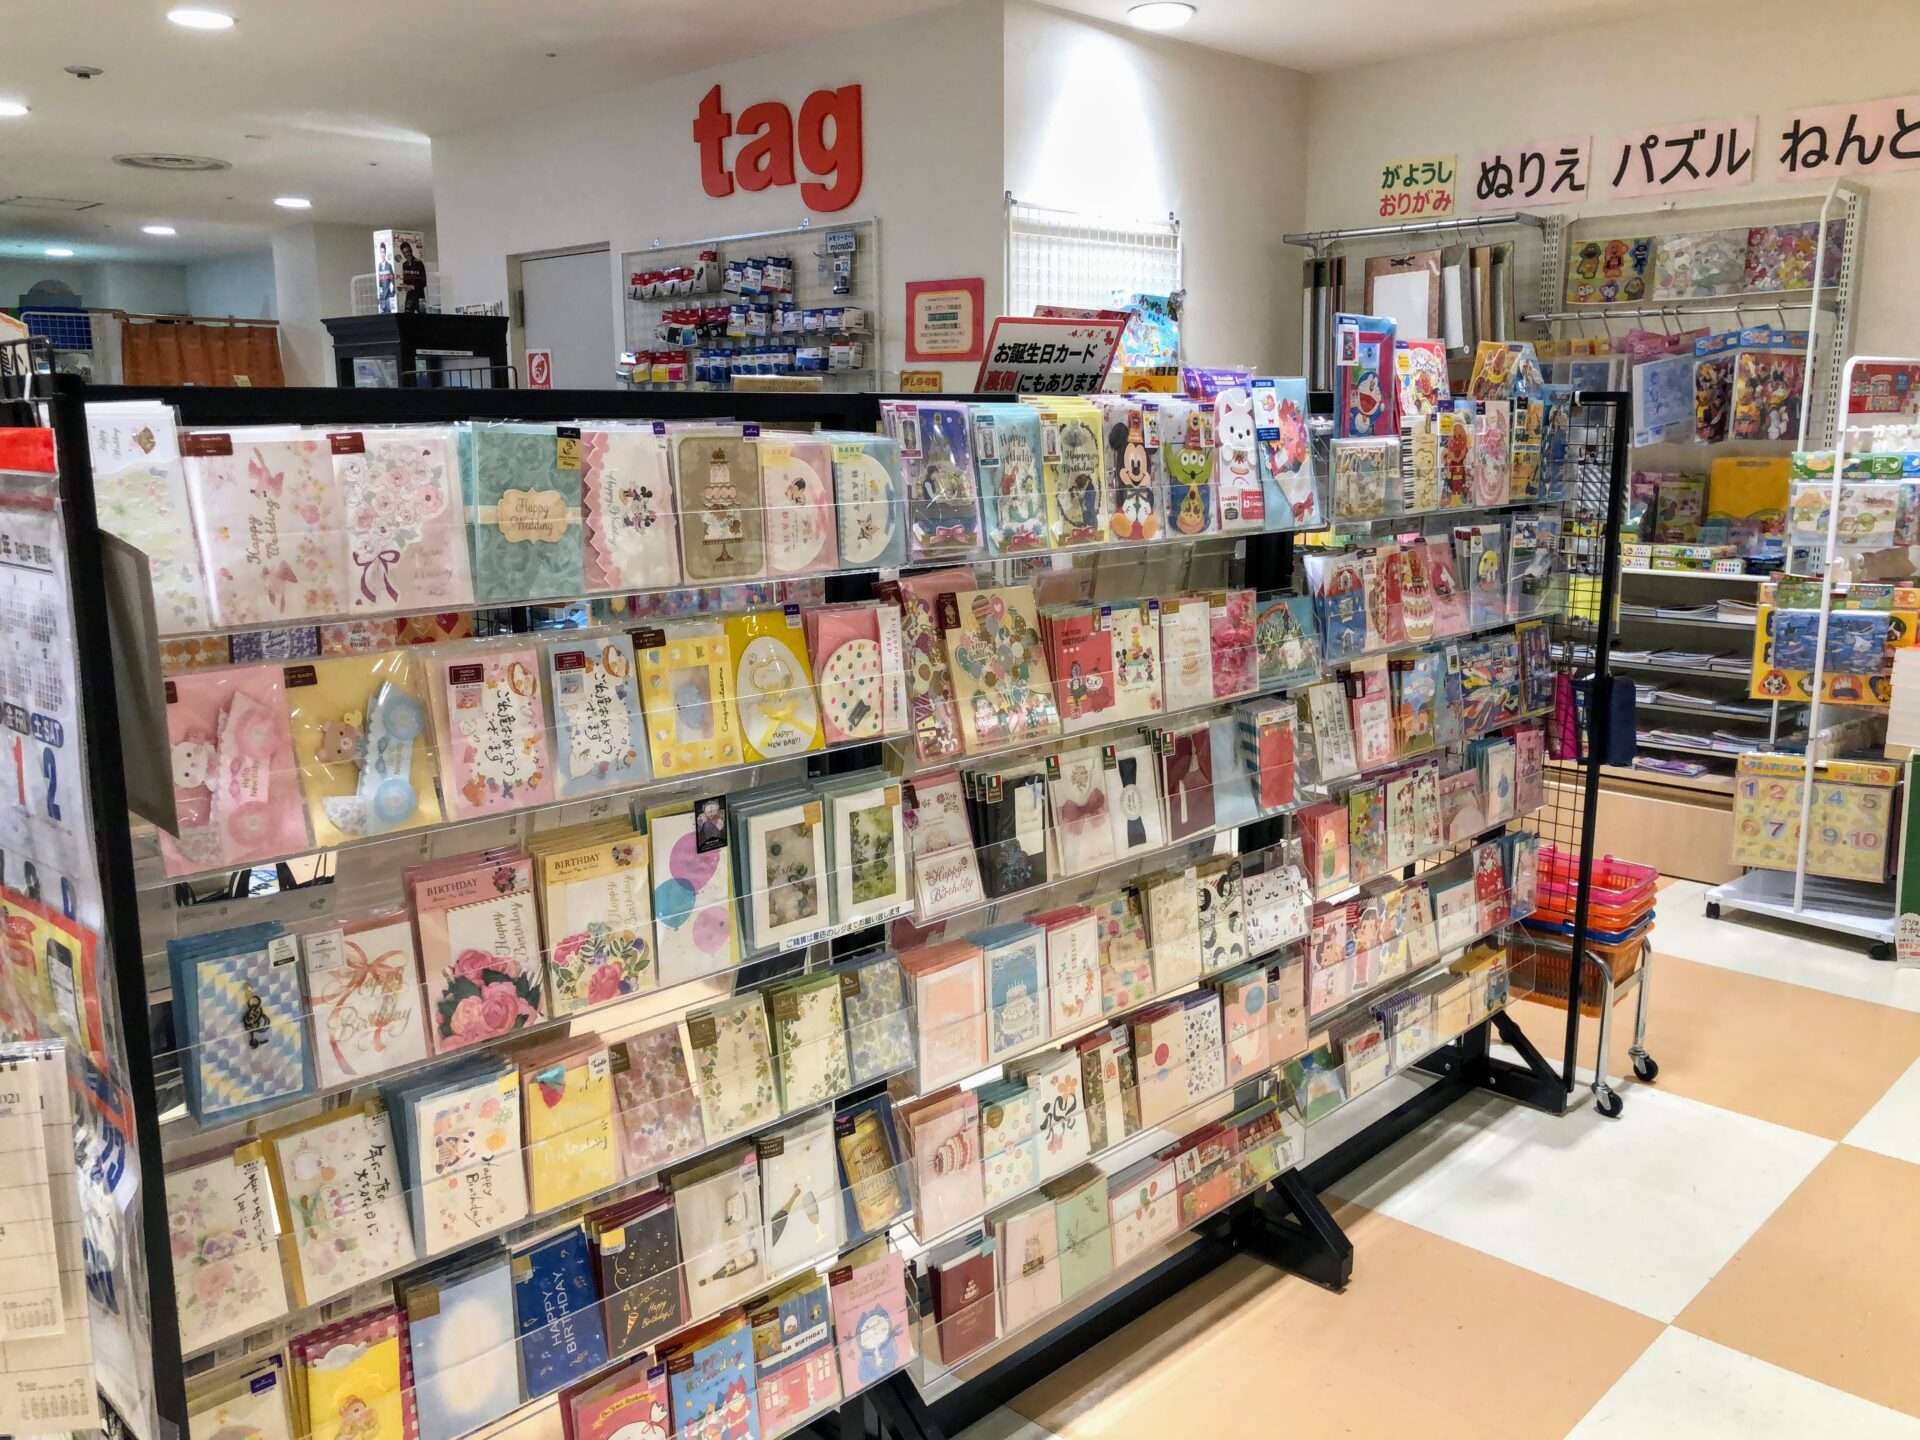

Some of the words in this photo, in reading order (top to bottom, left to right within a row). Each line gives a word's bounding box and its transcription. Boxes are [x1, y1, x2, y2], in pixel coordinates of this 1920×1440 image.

[692, 84, 863, 213] tag
[1612, 128, 1751, 187] パズル
[1382, 161, 1453, 189] がようし
[1476, 148, 1585, 200] ぬりえ
[1380, 189, 1452, 217] おりがみ
[830, 242, 854, 251] microSD
[993, 342, 1098, 364] お誕生日カード
[983, 370, 1103, 392] 裏側にもあります
[1062, 461, 1095, 473] Birthday
[1065, 450, 1090, 464] Happy
[516, 497, 551, 518] Happy
[246, 514, 264, 565] Happy
[265, 498, 281, 559] Wedding
[510, 517, 554, 536] Wedding
[720, 666, 730, 733] Congratulations
[768, 741, 781, 749] NEW
[773, 729, 794, 739] HAPPY
[13, 735, 26, 806] 1
[43, 747, 61, 822] 2
[1745, 782, 1755, 798] 1
[1769, 784, 1786, 801] 2
[1828, 790, 1844, 806] 4
[1863, 793, 1882, 809] 5
[1769, 821, 1785, 838] 7
[1823, 827, 1838, 843] 9
[1851, 831, 1879, 848] 10
[554, 852, 601, 871] BIRTHDAY
[925, 861, 968, 887] Happy
[426, 877, 478, 898] BIRTHDAY
[930, 875, 974, 905] Birthday
[607, 881, 623, 926] Happy
[624, 874, 639, 932] Birthday
[495, 911, 512, 956] Happy
[512, 900, 529, 964] Birthday
[327, 1006, 412, 1051] Birthday
[481, 1154, 500, 1197] Happy
[464, 1172, 486, 1229] Birthday
[542, 1290, 561, 1347] HAPPY
[641, 1303, 676, 1329] Birthday!!
[648, 1300, 668, 1314] Happy
[795, 1327, 825, 1348] BIRTHDAY
